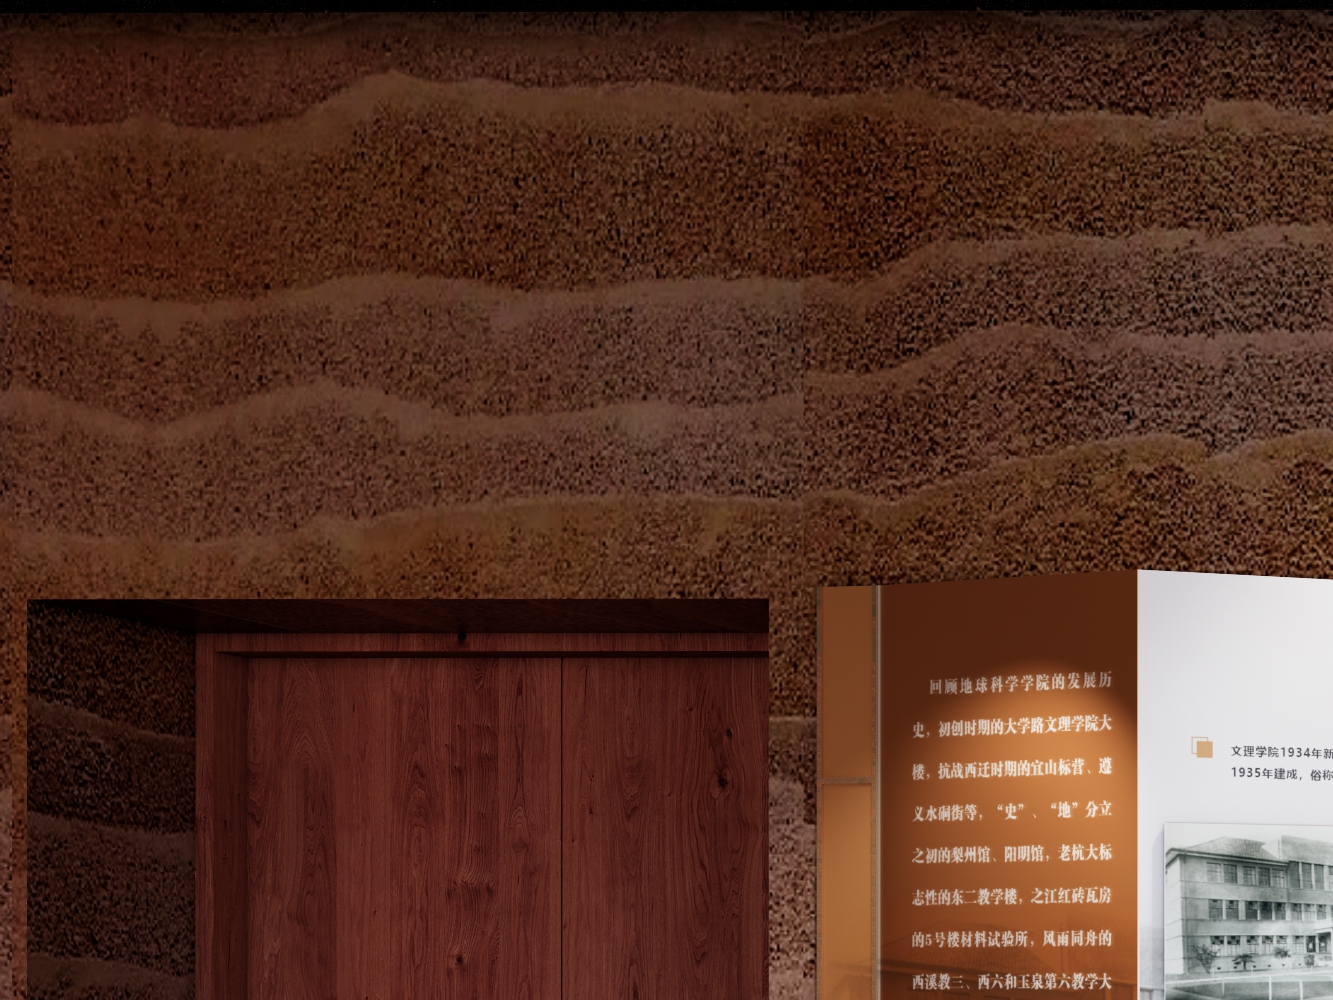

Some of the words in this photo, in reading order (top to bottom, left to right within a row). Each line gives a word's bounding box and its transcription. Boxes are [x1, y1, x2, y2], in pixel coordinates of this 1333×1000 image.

[929, 670, 1113, 695] 回顾地球科学学院的发展历
[912, 714, 1113, 739] 史，初创时期的大学路文理学院大
[912, 757, 1113, 781] 楼，抗战西迁时期的宜山标营、遵
[912, 886, 1112, 906] 志性的东二教学楼，之江红砖瓦房
[911, 930, 1113, 948] 的5号楼材料试验所，风雨同舟的
[912, 973, 1113, 990] 西溪教三、西六和玉泉第六教学大
